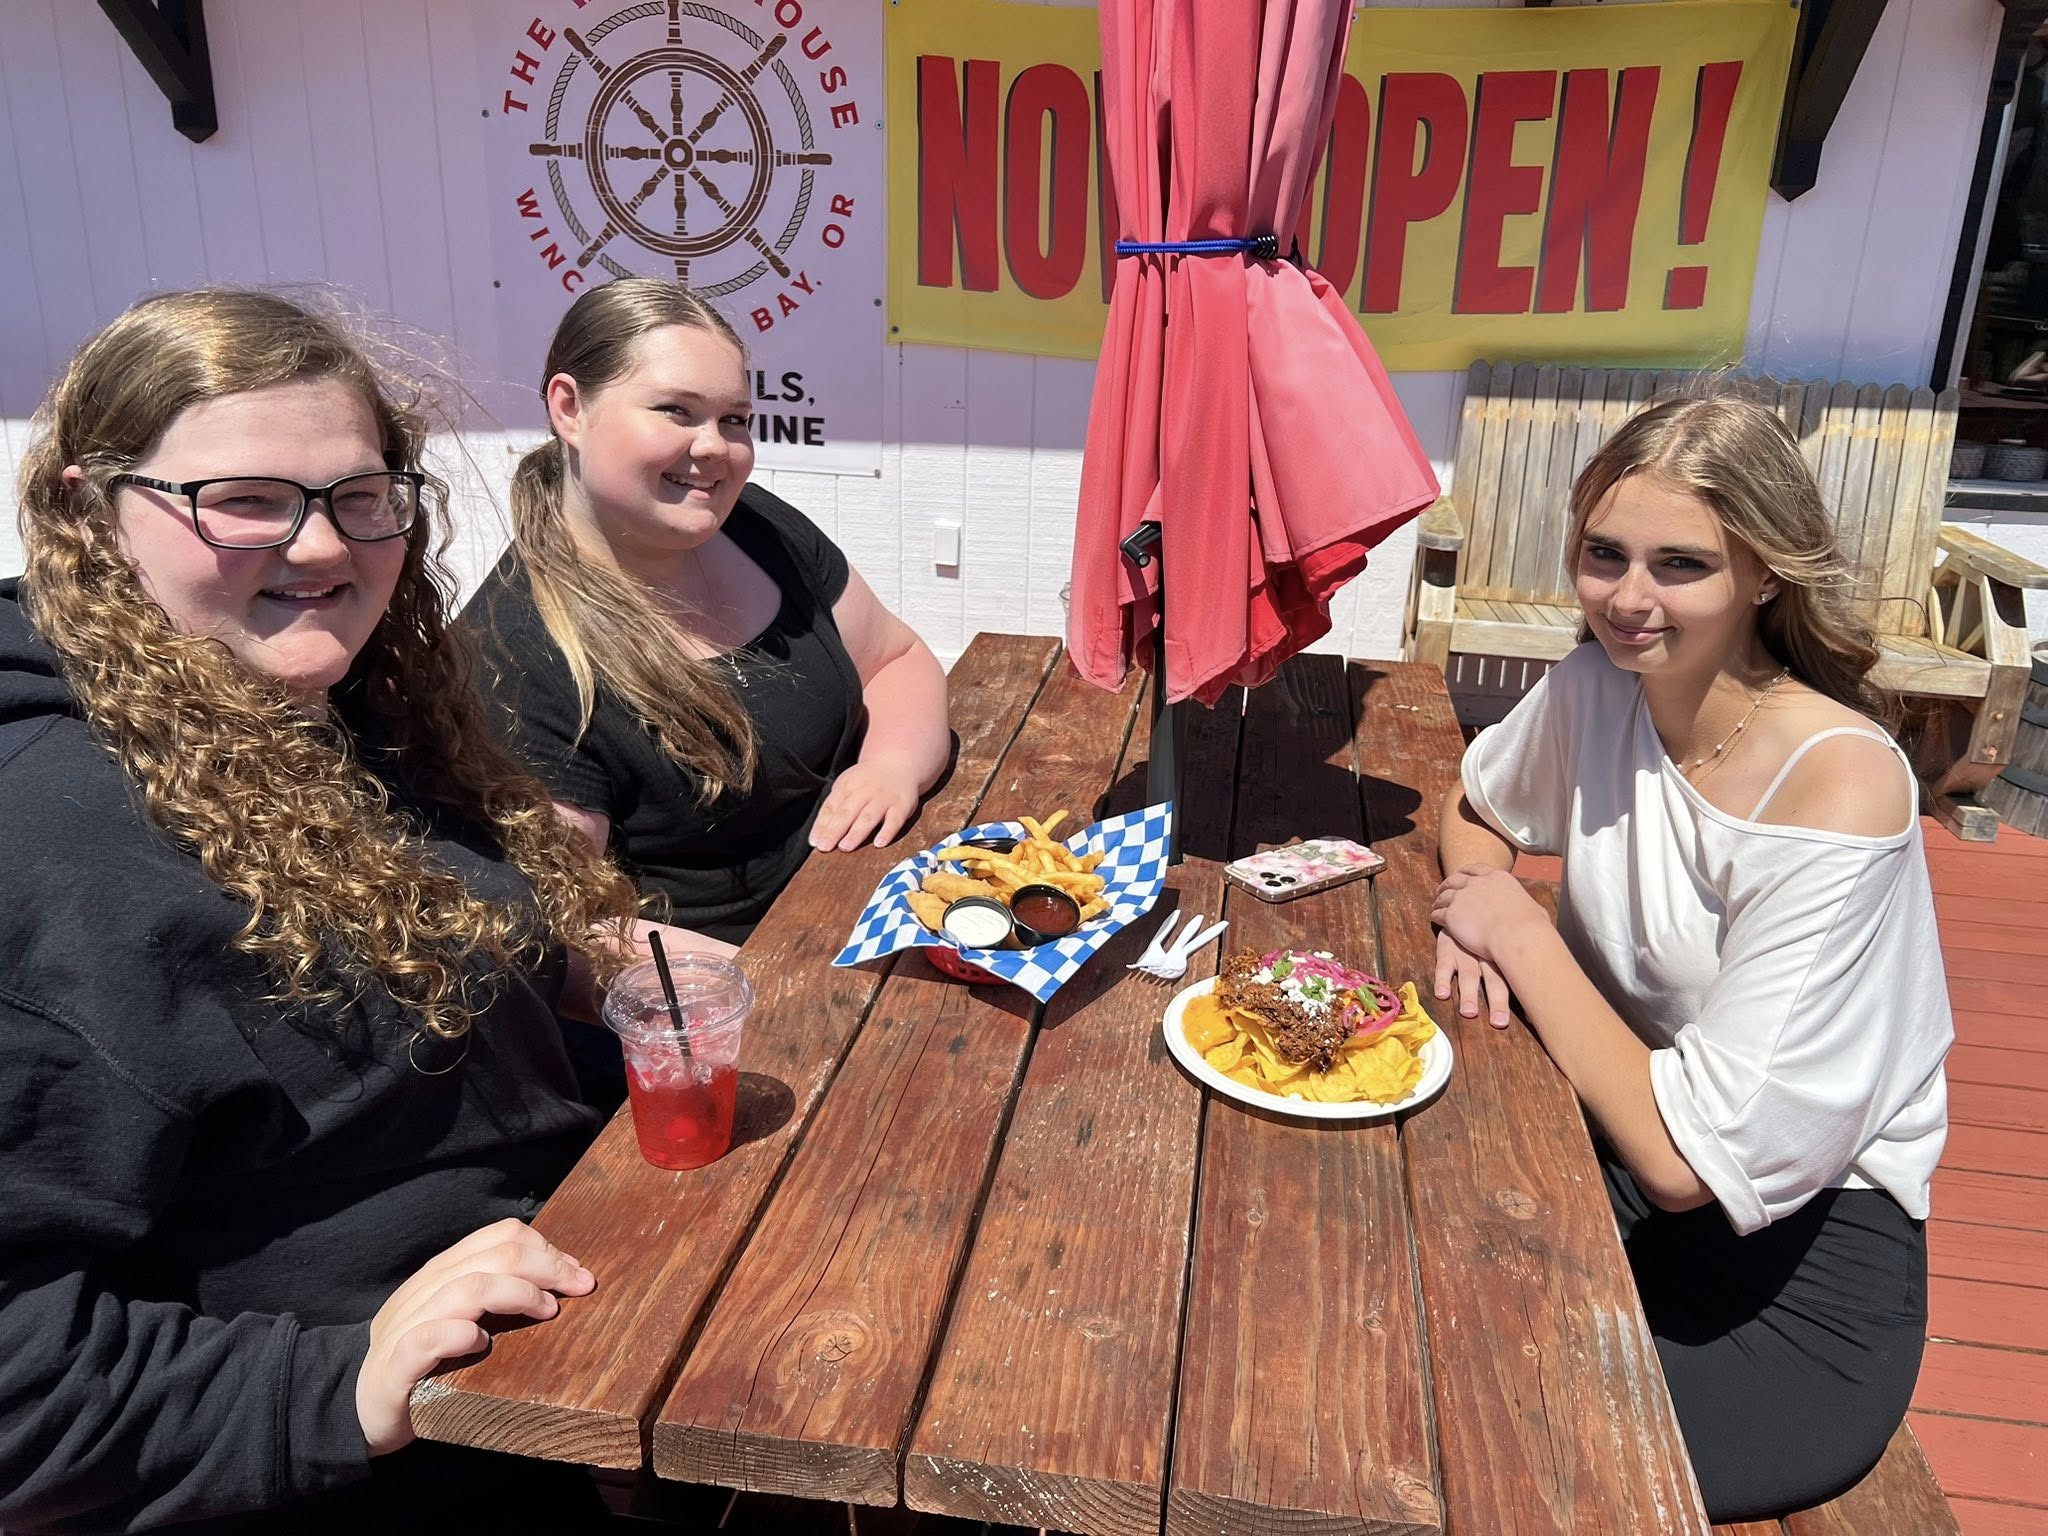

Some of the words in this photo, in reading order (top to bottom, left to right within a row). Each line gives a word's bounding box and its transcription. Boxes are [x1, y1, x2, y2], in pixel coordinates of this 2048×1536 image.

[503, 17, 556, 115] THE
[755, 0, 860, 129] OUSE
[917, 54, 1120, 305] NO
[516, 187, 585, 294] WINC
[822, 194, 855, 249] OR
[748, 413, 826, 446] INE
